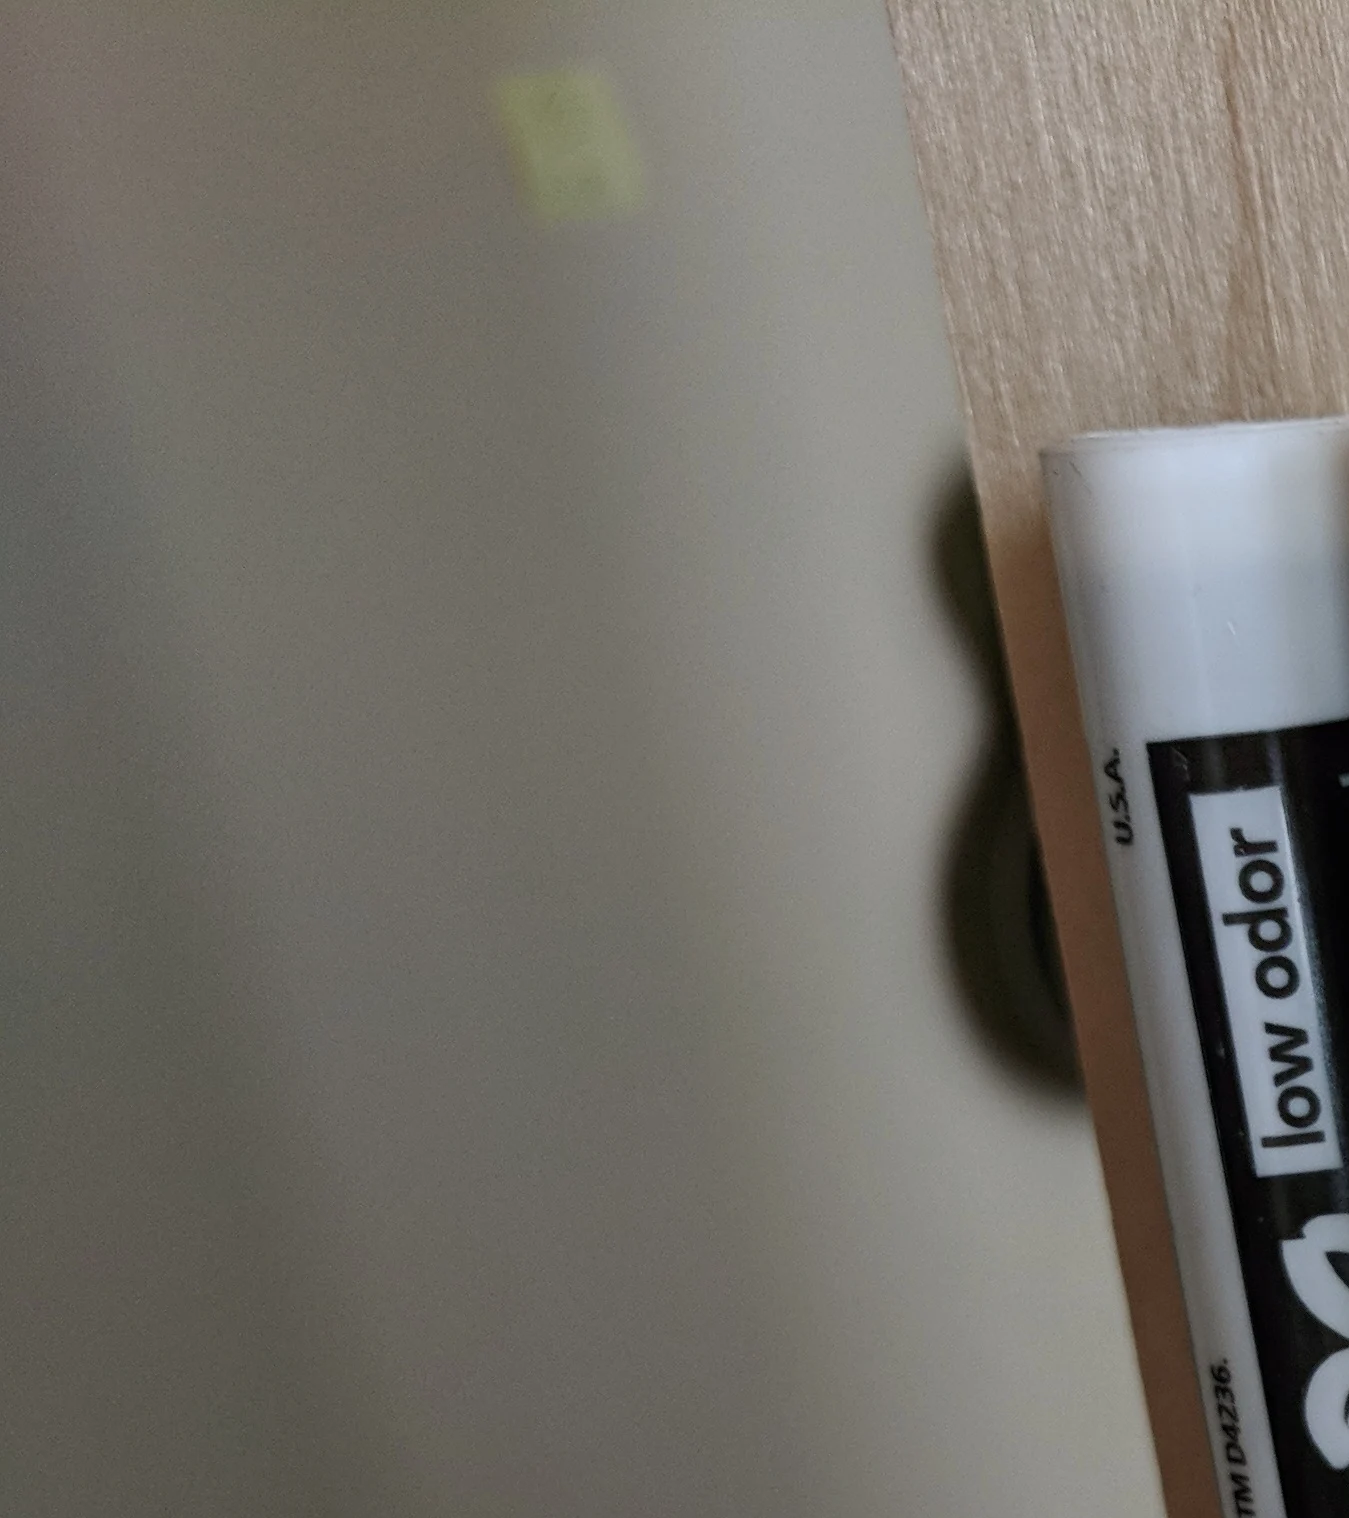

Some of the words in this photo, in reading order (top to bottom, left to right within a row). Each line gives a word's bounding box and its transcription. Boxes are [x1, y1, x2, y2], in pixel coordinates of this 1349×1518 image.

[1103, 748, 1134, 846] U.S.A.
[1222, 826, 1301, 1000] odor
[1261, 1021, 1327, 1150] low
